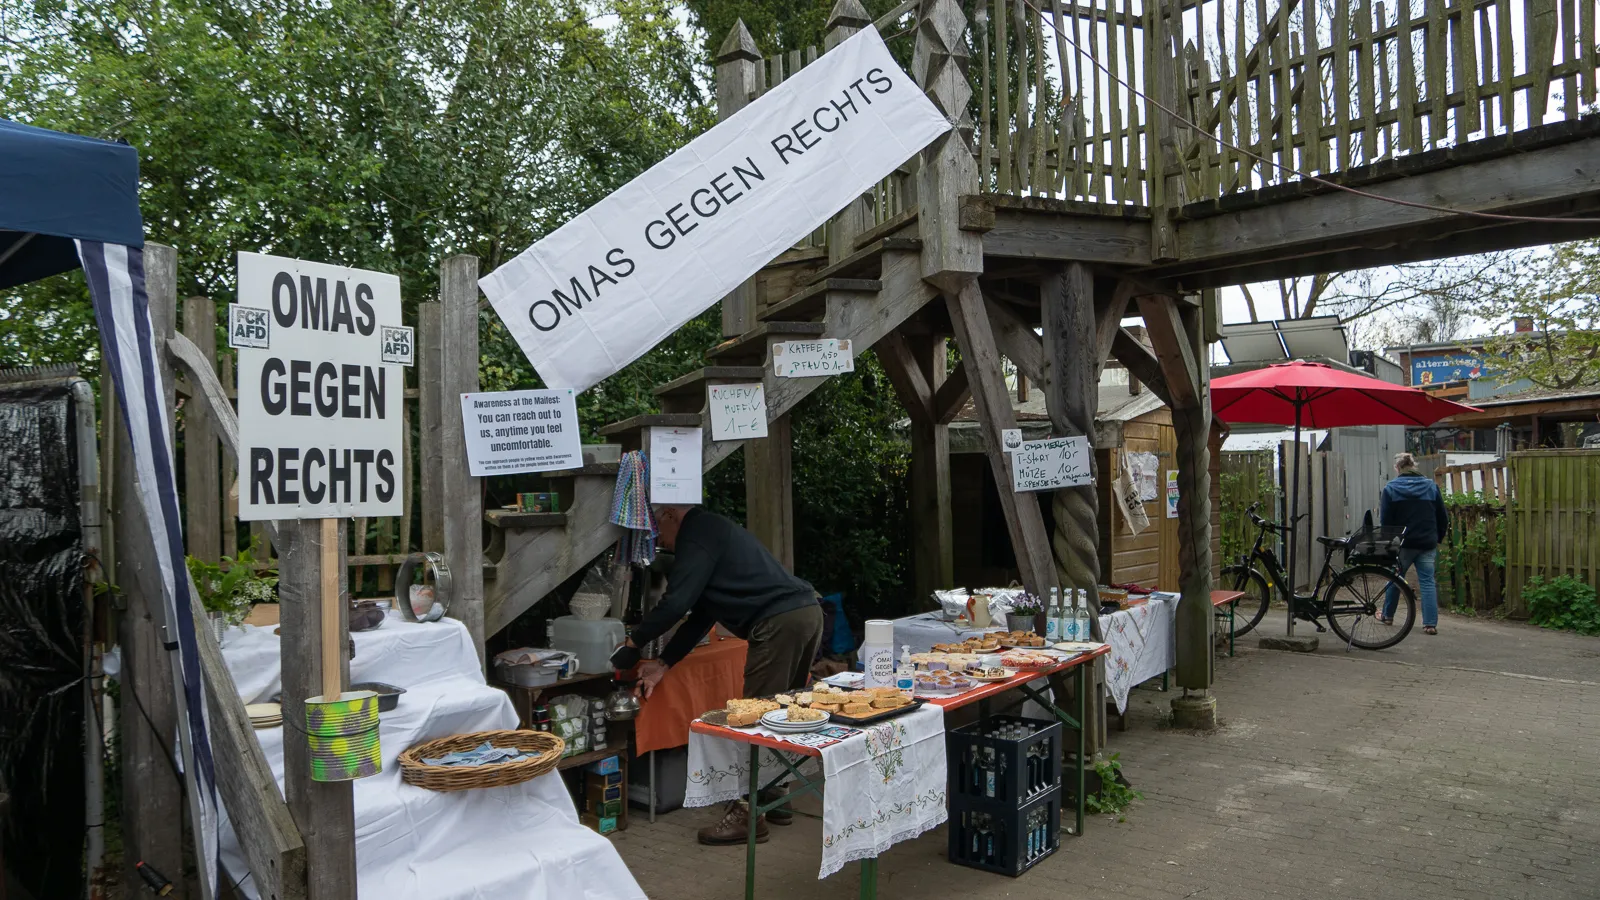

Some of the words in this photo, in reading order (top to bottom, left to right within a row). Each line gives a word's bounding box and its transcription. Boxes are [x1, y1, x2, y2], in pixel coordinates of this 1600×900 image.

[528, 248, 636, 332] OMAS
[644, 156, 766, 250] GEGEN
[770, 68, 893, 164] RECHTS
[272, 271, 376, 336] OMAS
[236, 309, 266, 326] FCK
[234, 324, 266, 340] AFD
[384, 329, 410, 344] FCK
[384, 342, 410, 356] AFD
[788, 343, 822, 354] KAFFEE
[792, 360, 830, 370] PFAND
[260, 357, 386, 420] GEGEN
[474, 399, 512, 408] Awareness
[522, 397, 532, 405] the
[534, 396, 560, 405] Maifest:
[477, 413, 493, 423] You
[495, 413, 510, 422] can
[512, 411, 536, 421] reach
[538, 410, 552, 420] out
[553, 410, 561, 418] to
[480, 429, 494, 438] us,
[495, 426, 528, 437] anytime
[531, 426, 545, 435] you
[547, 423, 562, 433] feel
[491, 439, 553, 452] uncomfortable.
[250, 447, 395, 504] RECHTS
